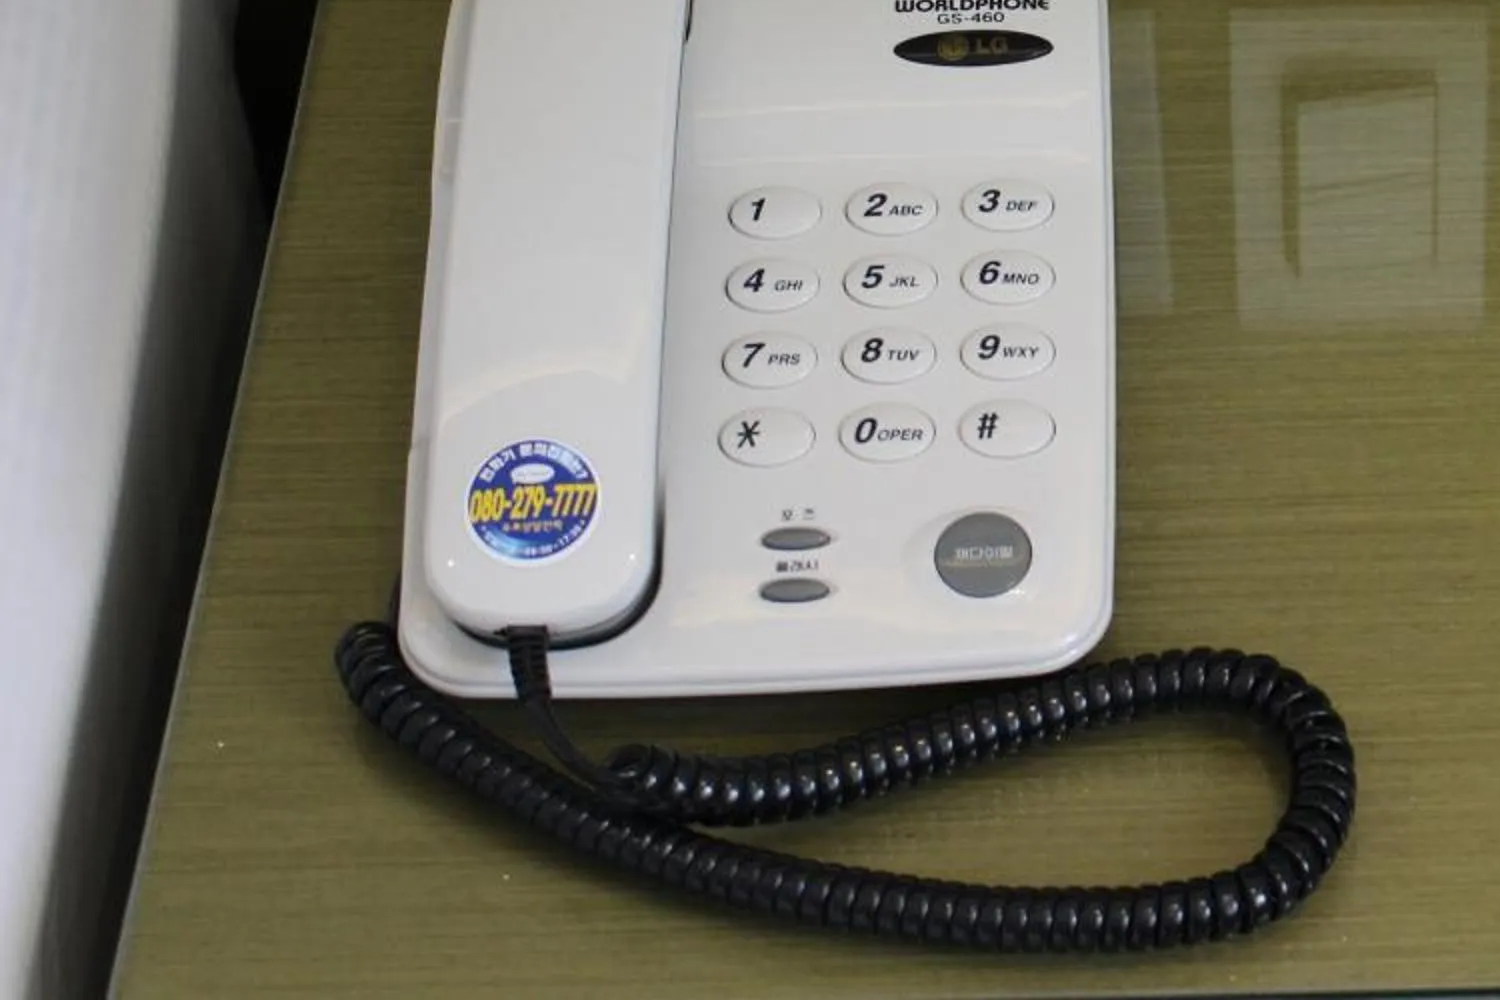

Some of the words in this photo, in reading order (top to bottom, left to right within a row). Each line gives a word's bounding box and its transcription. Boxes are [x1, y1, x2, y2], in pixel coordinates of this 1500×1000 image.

[937, 11, 1005, 25] GS-460
[975, 36, 1009, 55] LG
[750, 198, 766, 221] 1
[864, 193, 888, 217] 2
[888, 204, 923, 217] ABC
[978, 189, 1001, 212] 3
[1006, 200, 1038, 212] DEF
[743, 268, 766, 292] 4
[773, 280, 803, 292] GHI
[861, 265, 886, 289] 5
[889, 275, 920, 288] JKL
[978, 261, 1001, 286] 6
[1001, 272, 1040, 285] MNO
[742, 343, 766, 368] 7
[767, 353, 801, 366] PRS
[860, 338, 883, 363] 8
[887, 349, 921, 362] TUV
[978, 335, 1001, 360] 9
[1002, 346, 1040, 359] WXY
[877, 429, 923, 441] OPER
[977, 413, 999, 439] #
[469, 483, 597, 523] 080-279-7777
